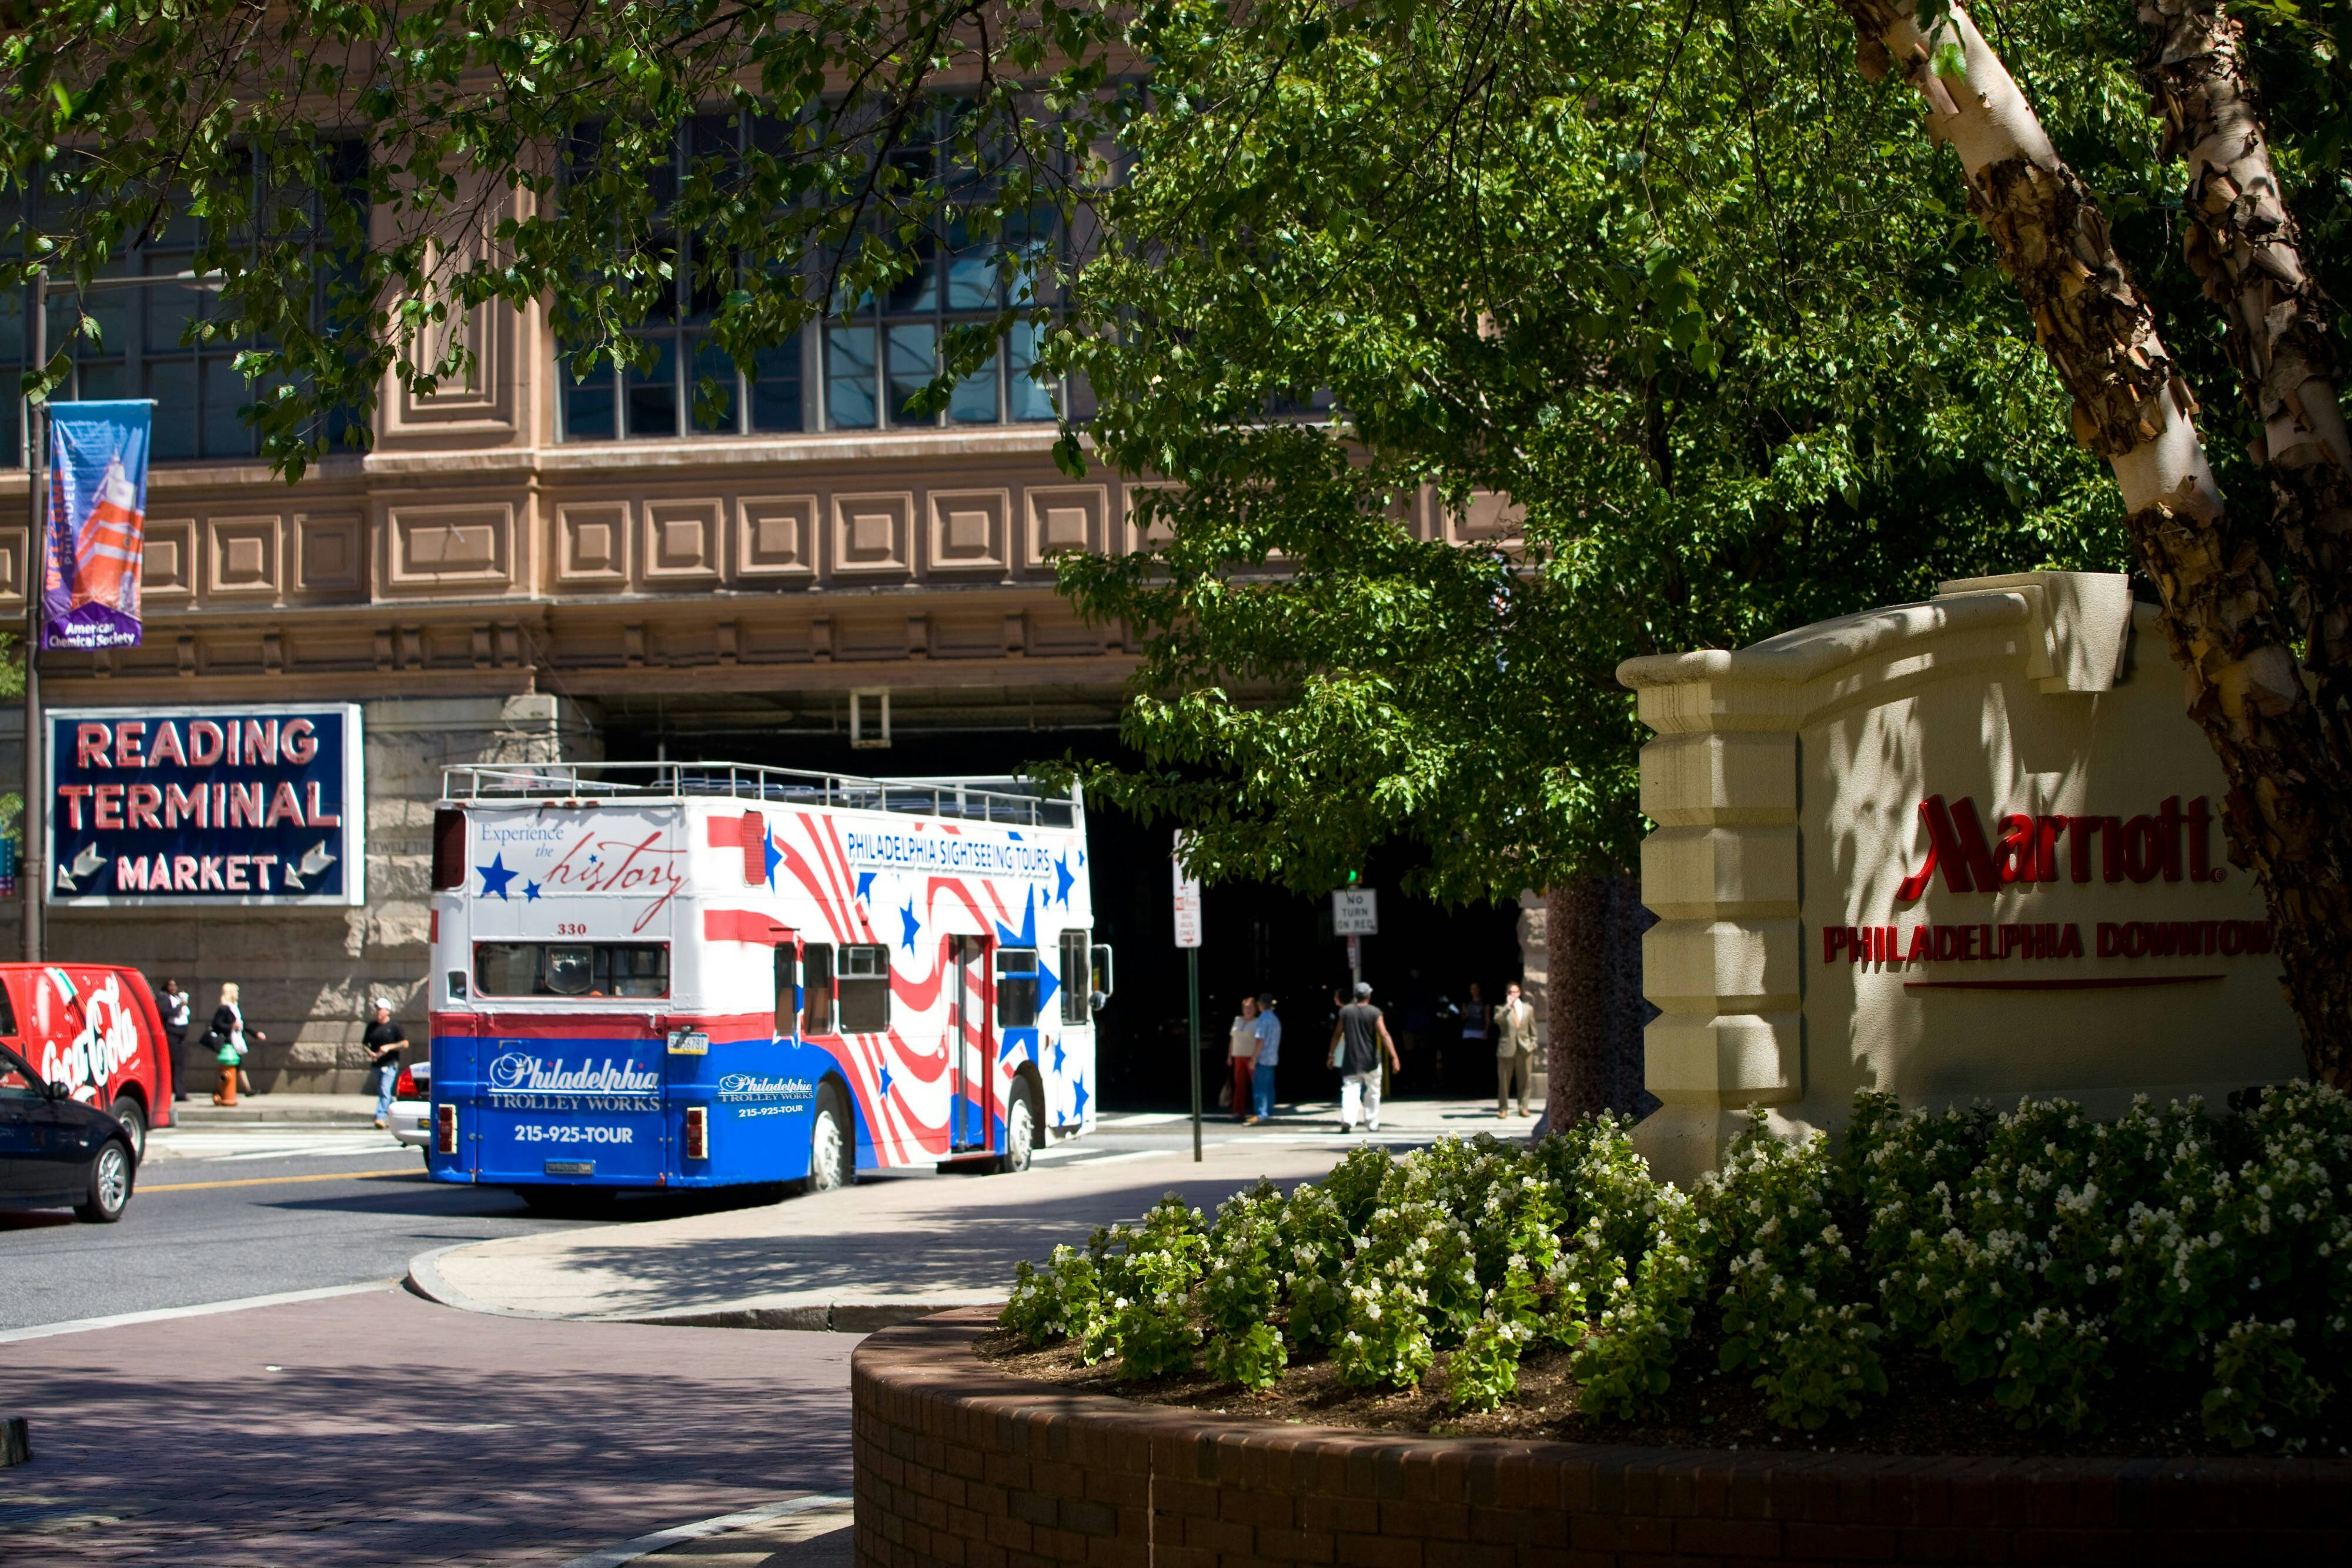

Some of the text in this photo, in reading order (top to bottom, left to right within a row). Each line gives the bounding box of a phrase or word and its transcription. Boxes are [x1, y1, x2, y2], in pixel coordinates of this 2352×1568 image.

[64, 442, 76, 565] PHILADELPHIA
[45, 467, 64, 591] WELCOME
[65, 621, 115, 635] American
[48, 631, 135, 647] Chemical Society
[78, 718, 319, 768] READING
[58, 780, 341, 831] TERMINAL
[480, 823, 564, 847] Experience
[534, 843, 554, 858] the
[848, 833, 1050, 871] PHILADELPHIA SIGHTSEEING TOURS
[1895, 794, 2214, 901] Marriott
[117, 852, 278, 891] MARKET
[543, 831, 690, 934] history
[1347, 895, 1364, 905] NO
[1342, 907, 1368, 917] TURN
[557, 923, 587, 935] 330
[1337, 919, 1374, 929] ON RED
[1823, 920, 2280, 964] PHILADELPHIA DOWNTOW
[489, 1052, 659, 1094] Philadelphia
[719, 1074, 813, 1093] Philadelphia
[489, 1093, 660, 1111] TROLLEY WORKS
[719, 1094, 779, 1102] TROLLEY
[738, 1105, 804, 1118] 215-925-TOUR
[514, 1124, 633, 1144] 215-925-TOUR
